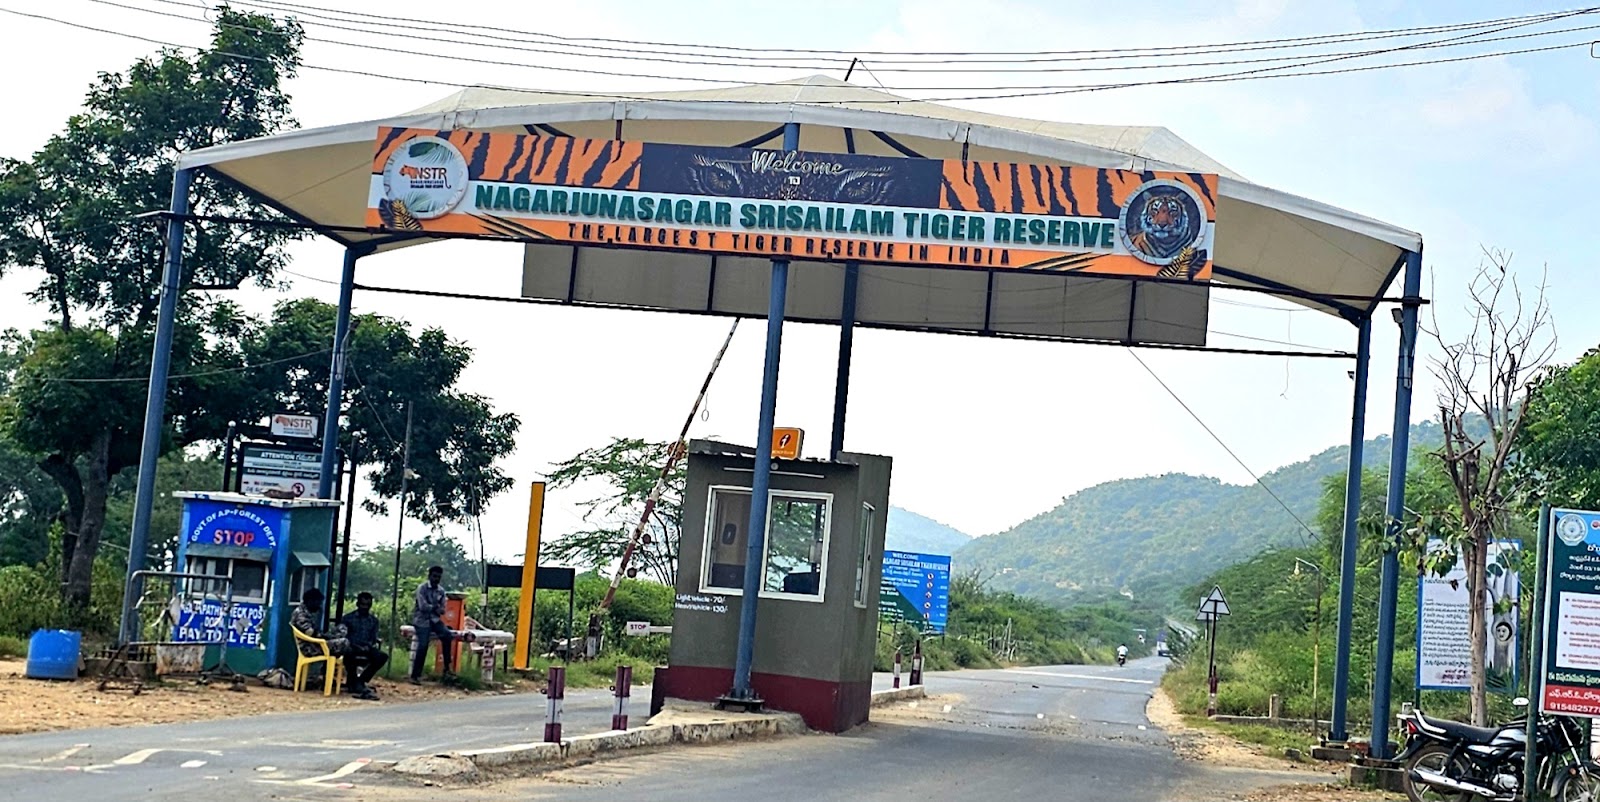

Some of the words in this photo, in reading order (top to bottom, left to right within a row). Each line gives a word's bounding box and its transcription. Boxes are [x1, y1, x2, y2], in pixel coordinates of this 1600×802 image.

[752, 150, 846, 175] Welcome
[416, 166, 450, 185] NSTR
[475, 184, 732, 227] NAGARJUNASAGAR
[740, 203, 894, 237] SRISAILAM
[904, 213, 985, 241] TIGER
[994, 217, 1115, 248] RESERVE
[568, 223, 605, 240] THE
[615, 226, 717, 248] LARGEST
[732, 234, 793, 252] TIGER
[806, 239, 894, 259] RESERVE
[909, 245, 929, 261] IN
[948, 246, 1010, 265] INDIA
[261, 451, 295, 460] ATTENTION
[213, 529, 255, 545] STOP
[892, 552, 919, 560] WELCOME
[179, 627, 201, 640] PAY
[206, 629, 237, 643] TOL
[1550, 702, 1600, 714] 915482577
